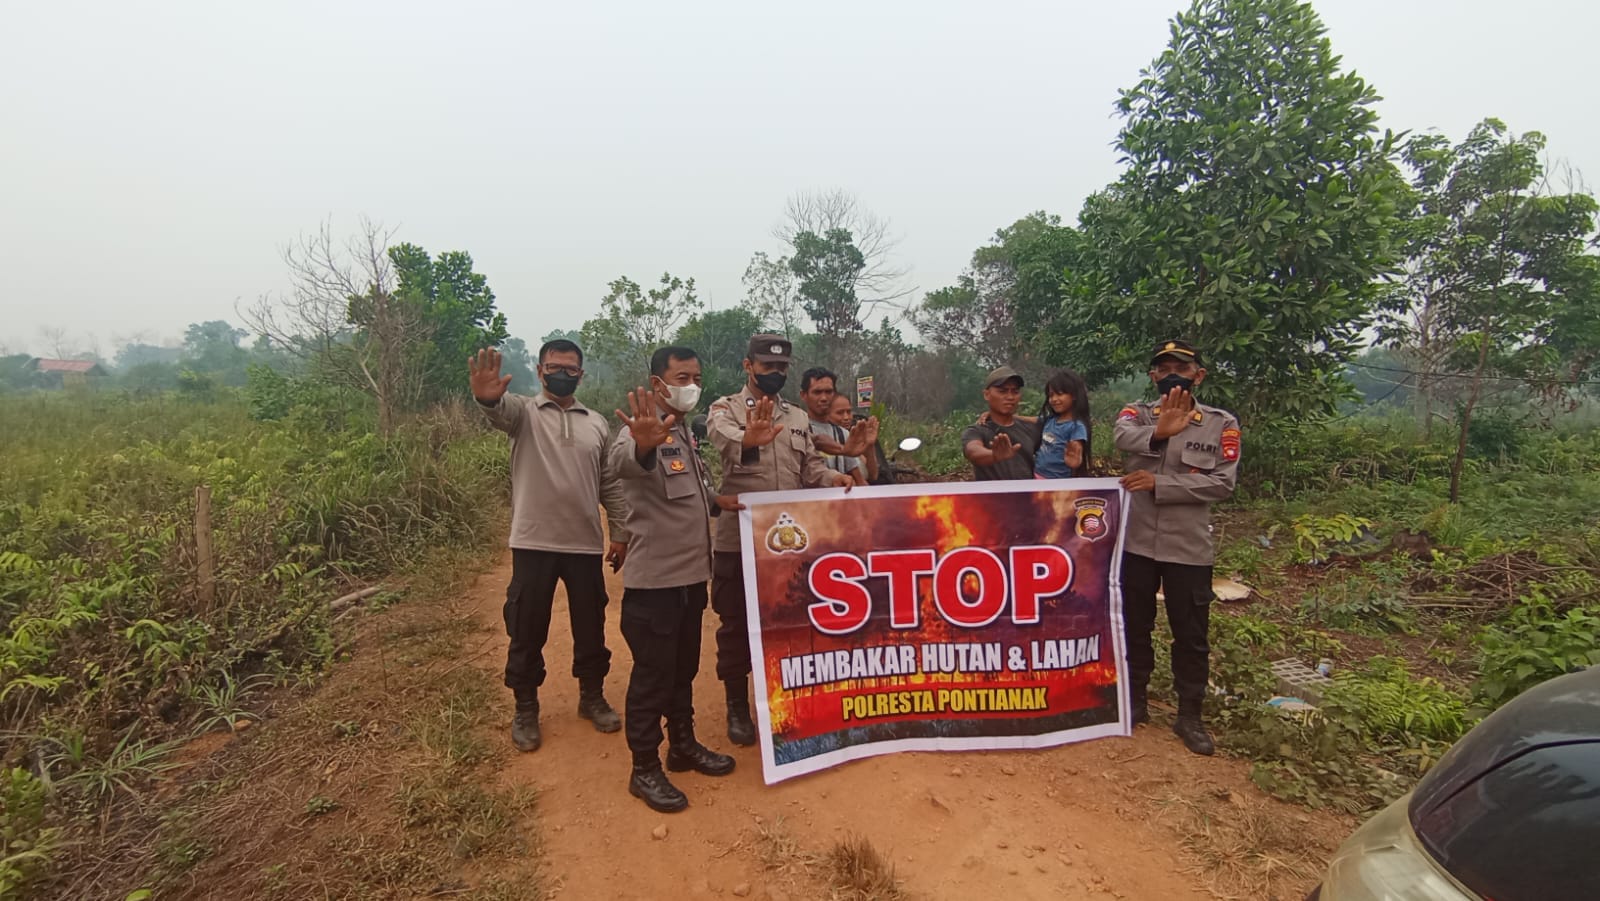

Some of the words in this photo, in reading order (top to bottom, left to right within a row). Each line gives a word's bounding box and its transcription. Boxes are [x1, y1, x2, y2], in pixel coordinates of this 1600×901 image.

[790, 428, 808, 438] POL
[1185, 441, 1217, 453] POLRI
[808, 545, 1073, 635] STOP
[780, 644, 916, 689] MEMBAKAR
[920, 641, 1002, 672] HUTAN
[1007, 645, 1027, 672] &
[1031, 634, 1100, 669] LAHAN
[842, 693, 935, 720] POLRESTA
[938, 687, 1048, 714] PONTIANAK
